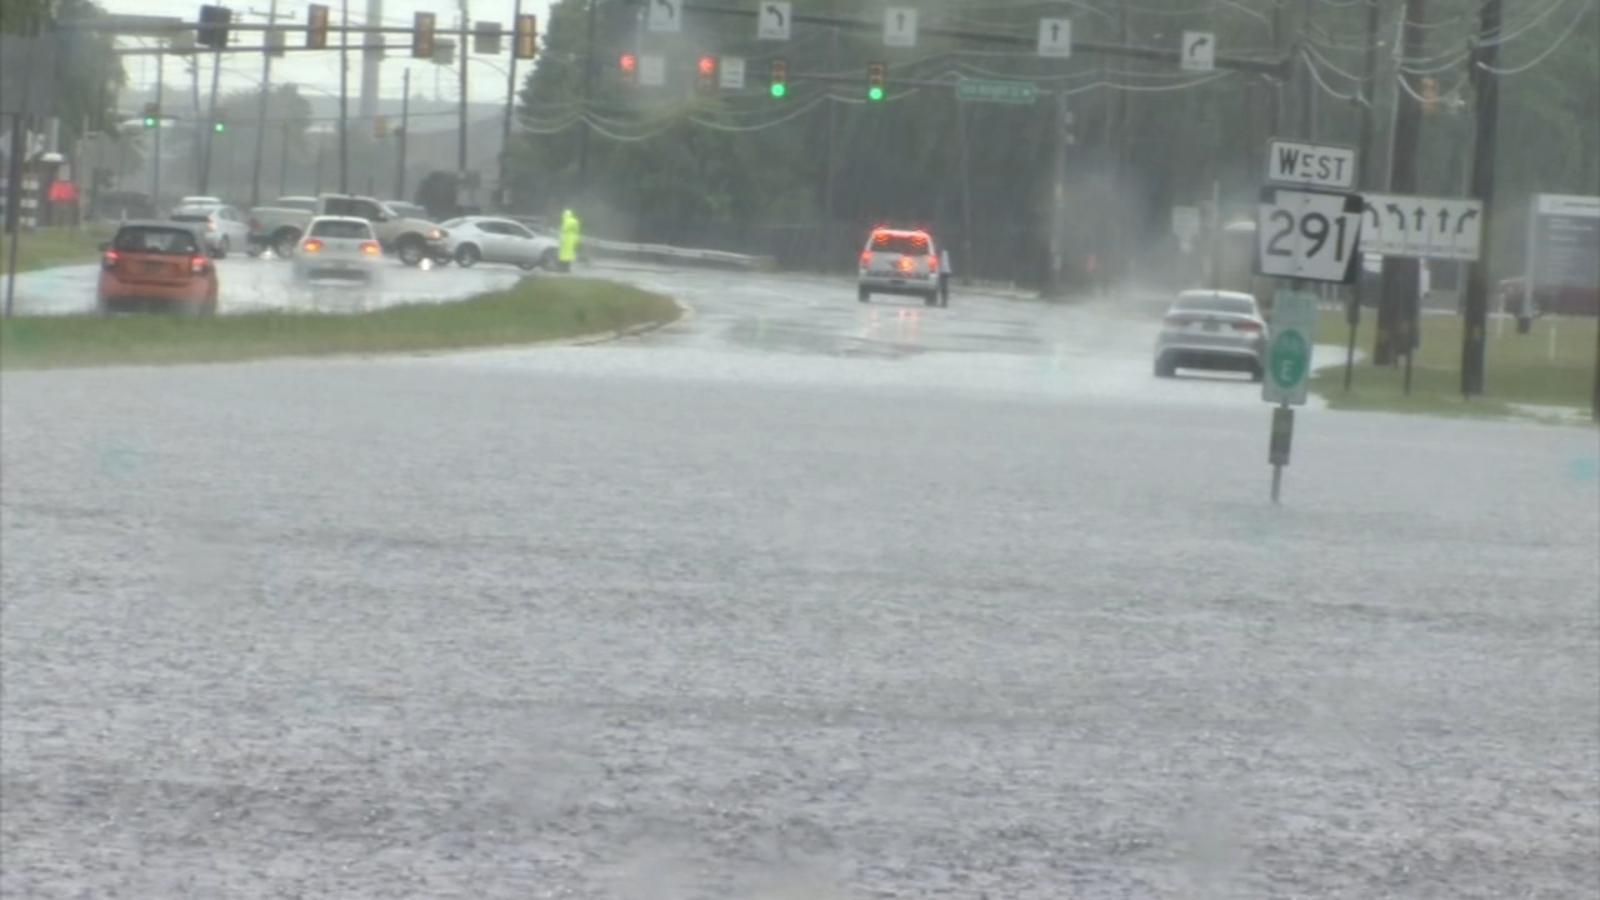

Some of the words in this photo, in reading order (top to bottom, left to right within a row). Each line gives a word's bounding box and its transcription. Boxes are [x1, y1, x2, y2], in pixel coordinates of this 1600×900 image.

[1279, 147, 1346, 181] WEST
[1266, 209, 1347, 262] 291
[1280, 359, 1294, 381] E
